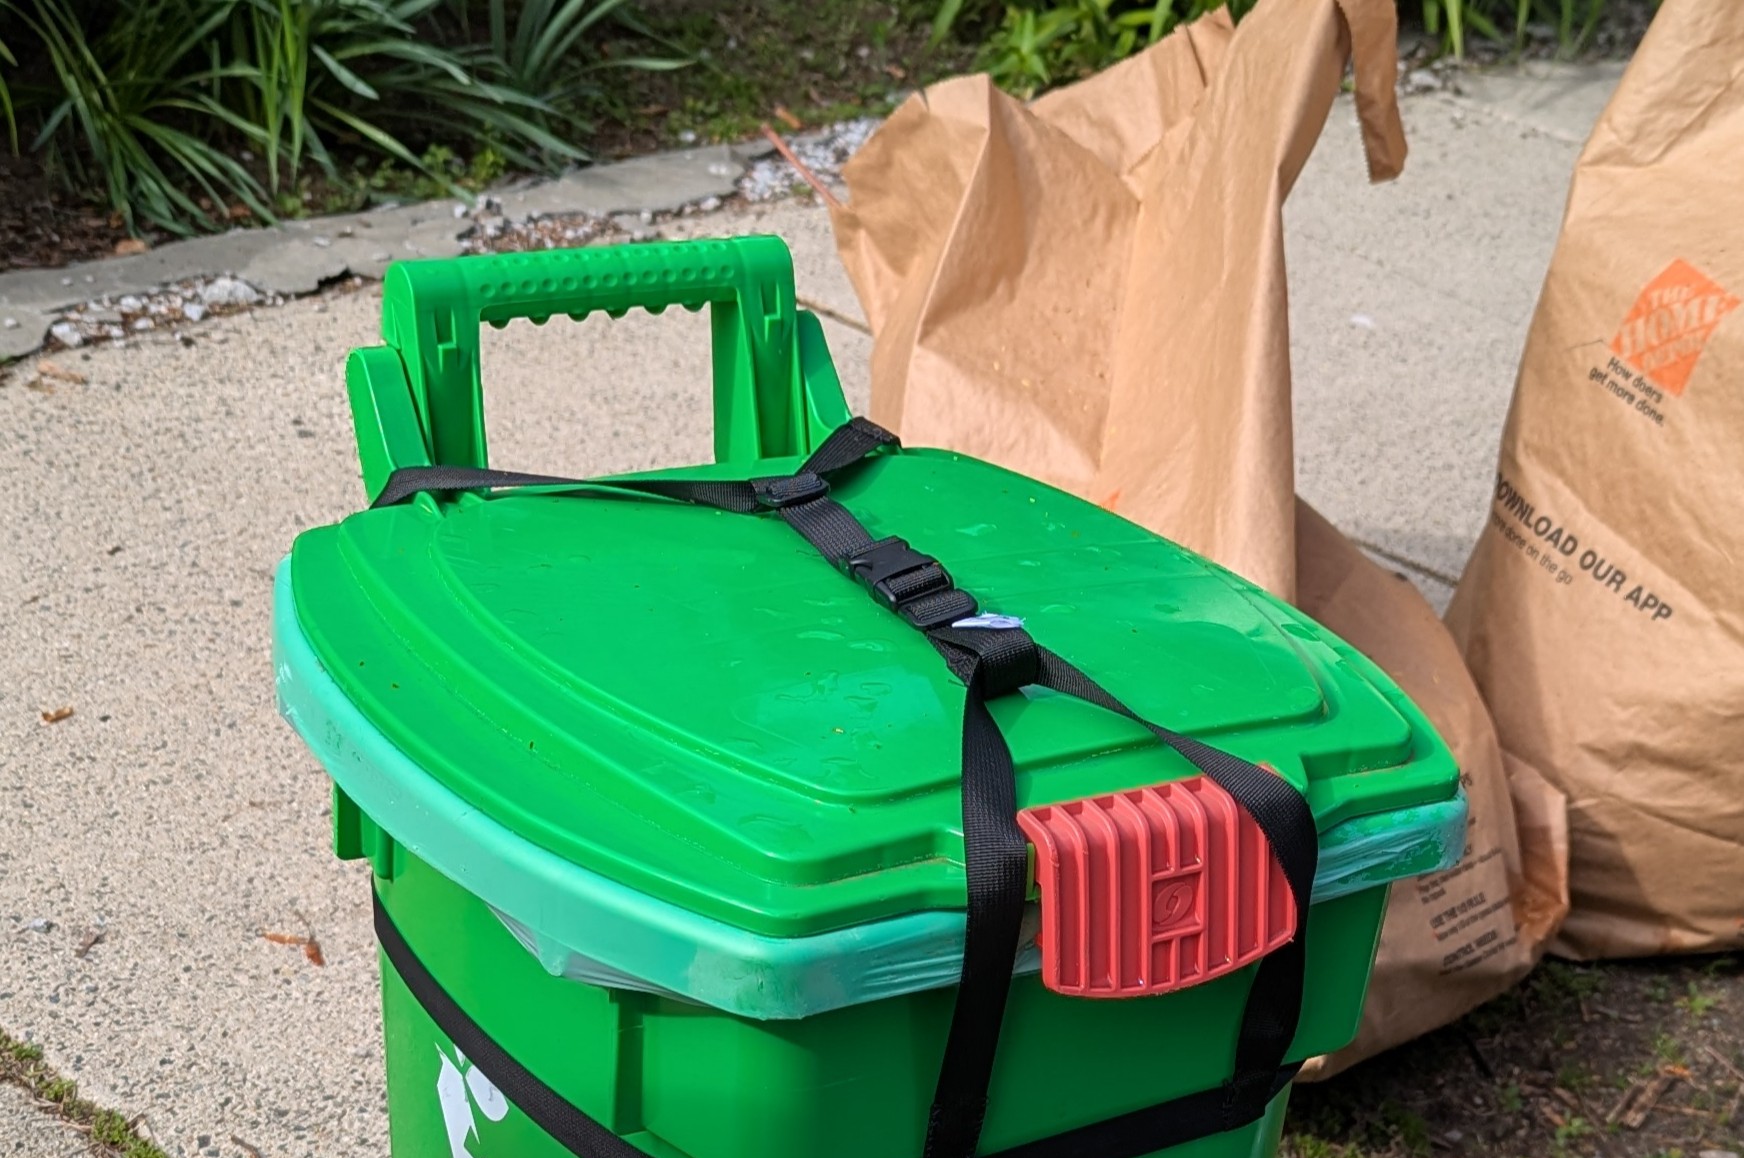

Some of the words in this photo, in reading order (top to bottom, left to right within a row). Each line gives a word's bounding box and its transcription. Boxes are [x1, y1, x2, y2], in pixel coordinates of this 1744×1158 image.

[1620, 294, 1723, 358] HOME
[1589, 367, 1608, 386] get
[1606, 380, 1635, 405] more
[1635, 399, 1664, 427] done.
[1607, 356, 1632, 381] How
[1632, 376, 1663, 404] doers
[1526, 545, 1540, 560] on
[1540, 554, 1558, 574] the
[1555, 570, 1573, 585] go
[1579, 550, 1627, 593] OUR
[1623, 585, 1673, 621] APP
